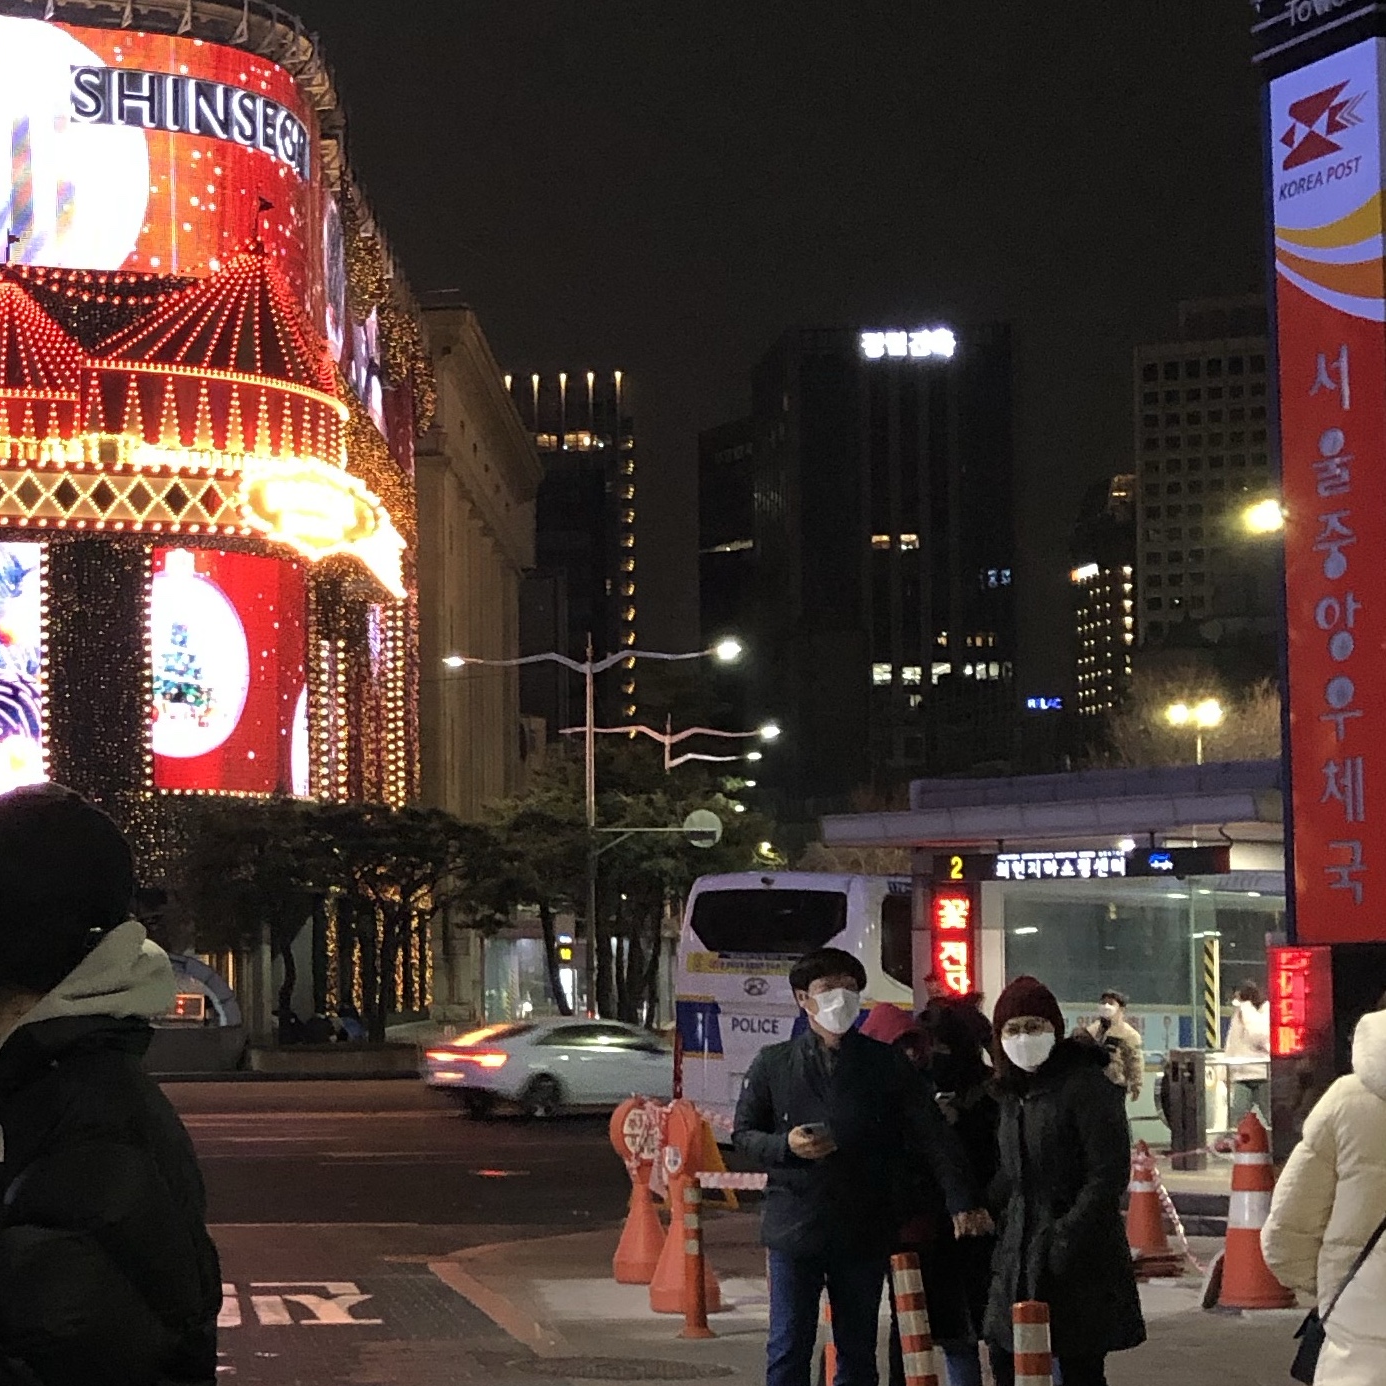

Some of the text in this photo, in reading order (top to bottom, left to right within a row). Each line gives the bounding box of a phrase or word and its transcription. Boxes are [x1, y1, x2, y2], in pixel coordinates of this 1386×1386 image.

[71, 66, 305, 170] SHINSEG
[1278, 155, 1362, 201] KOREA POST
[1309, 343, 1367, 906] 서울중앙우체국
[950, 855, 963, 880] 2
[731, 1016, 780, 1035] POLICE
